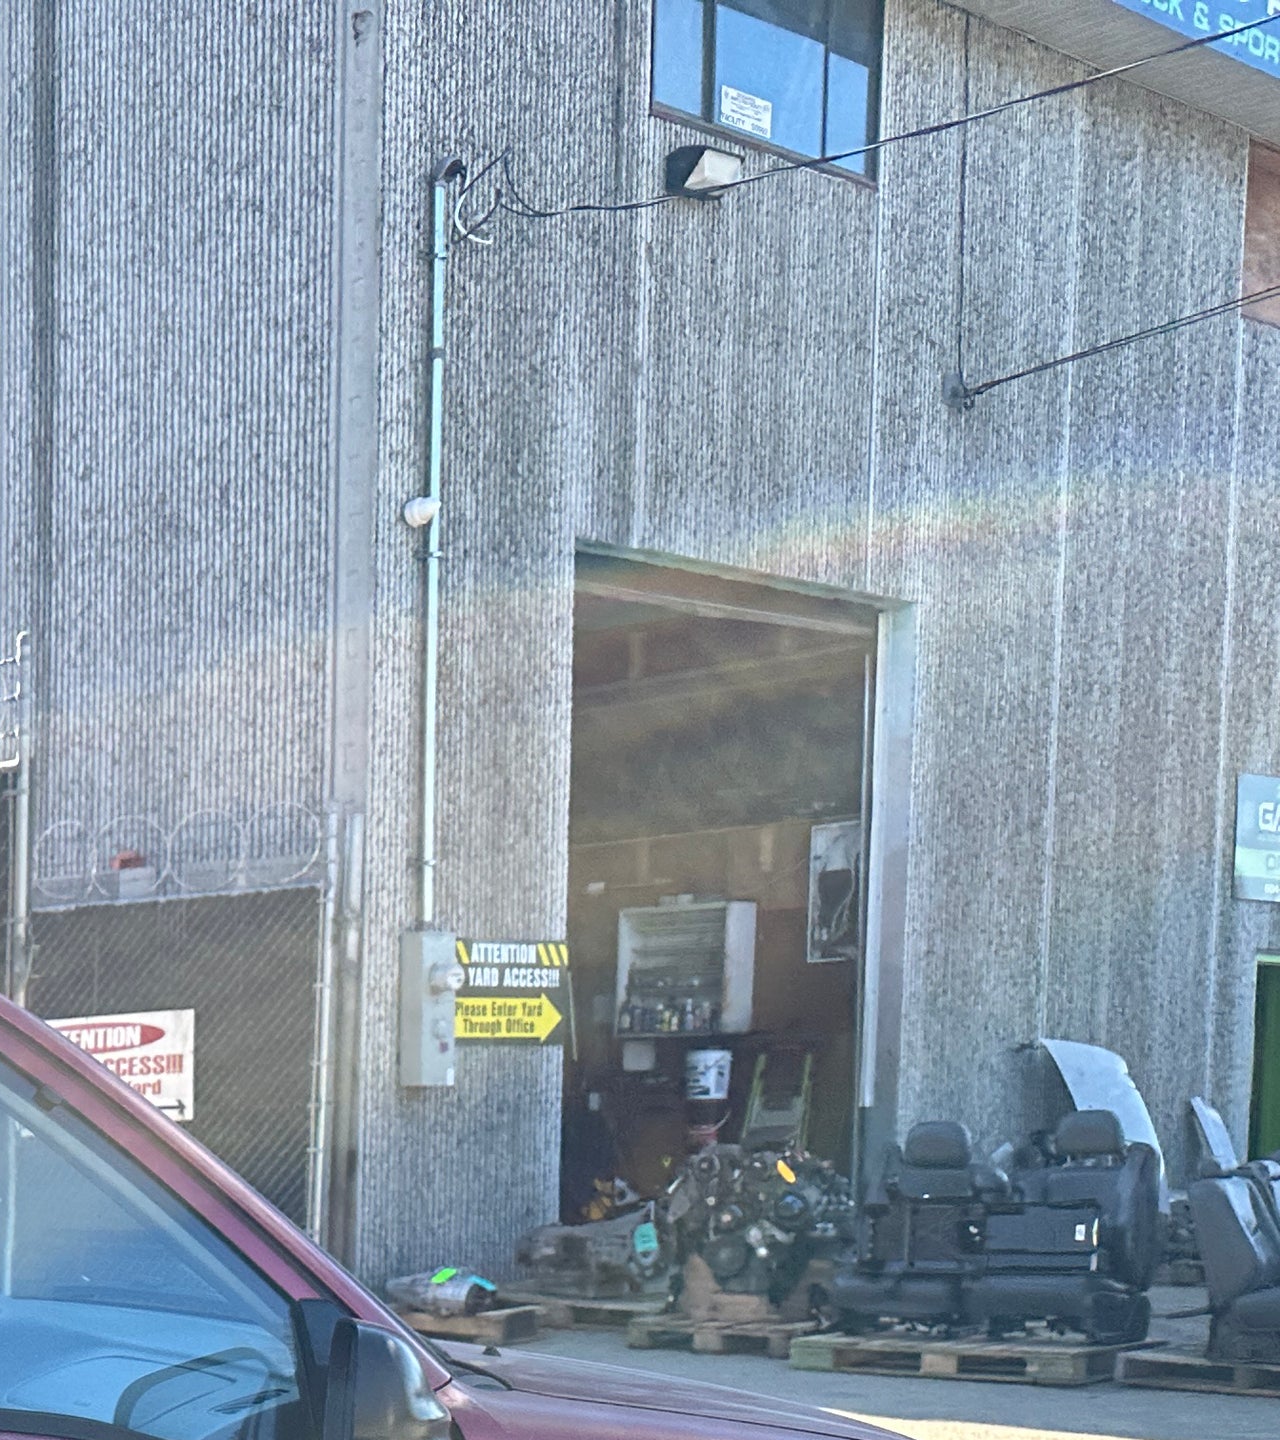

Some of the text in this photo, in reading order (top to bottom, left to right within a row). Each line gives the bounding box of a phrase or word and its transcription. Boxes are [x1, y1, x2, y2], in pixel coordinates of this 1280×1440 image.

[471, 943, 537, 964] ATTENTION
[468, 967, 499, 987] YARD
[491, 1002, 517, 1017] Enter
[522, 1002, 543, 1016] Yard
[463, 1019, 535, 1035] Through Office
